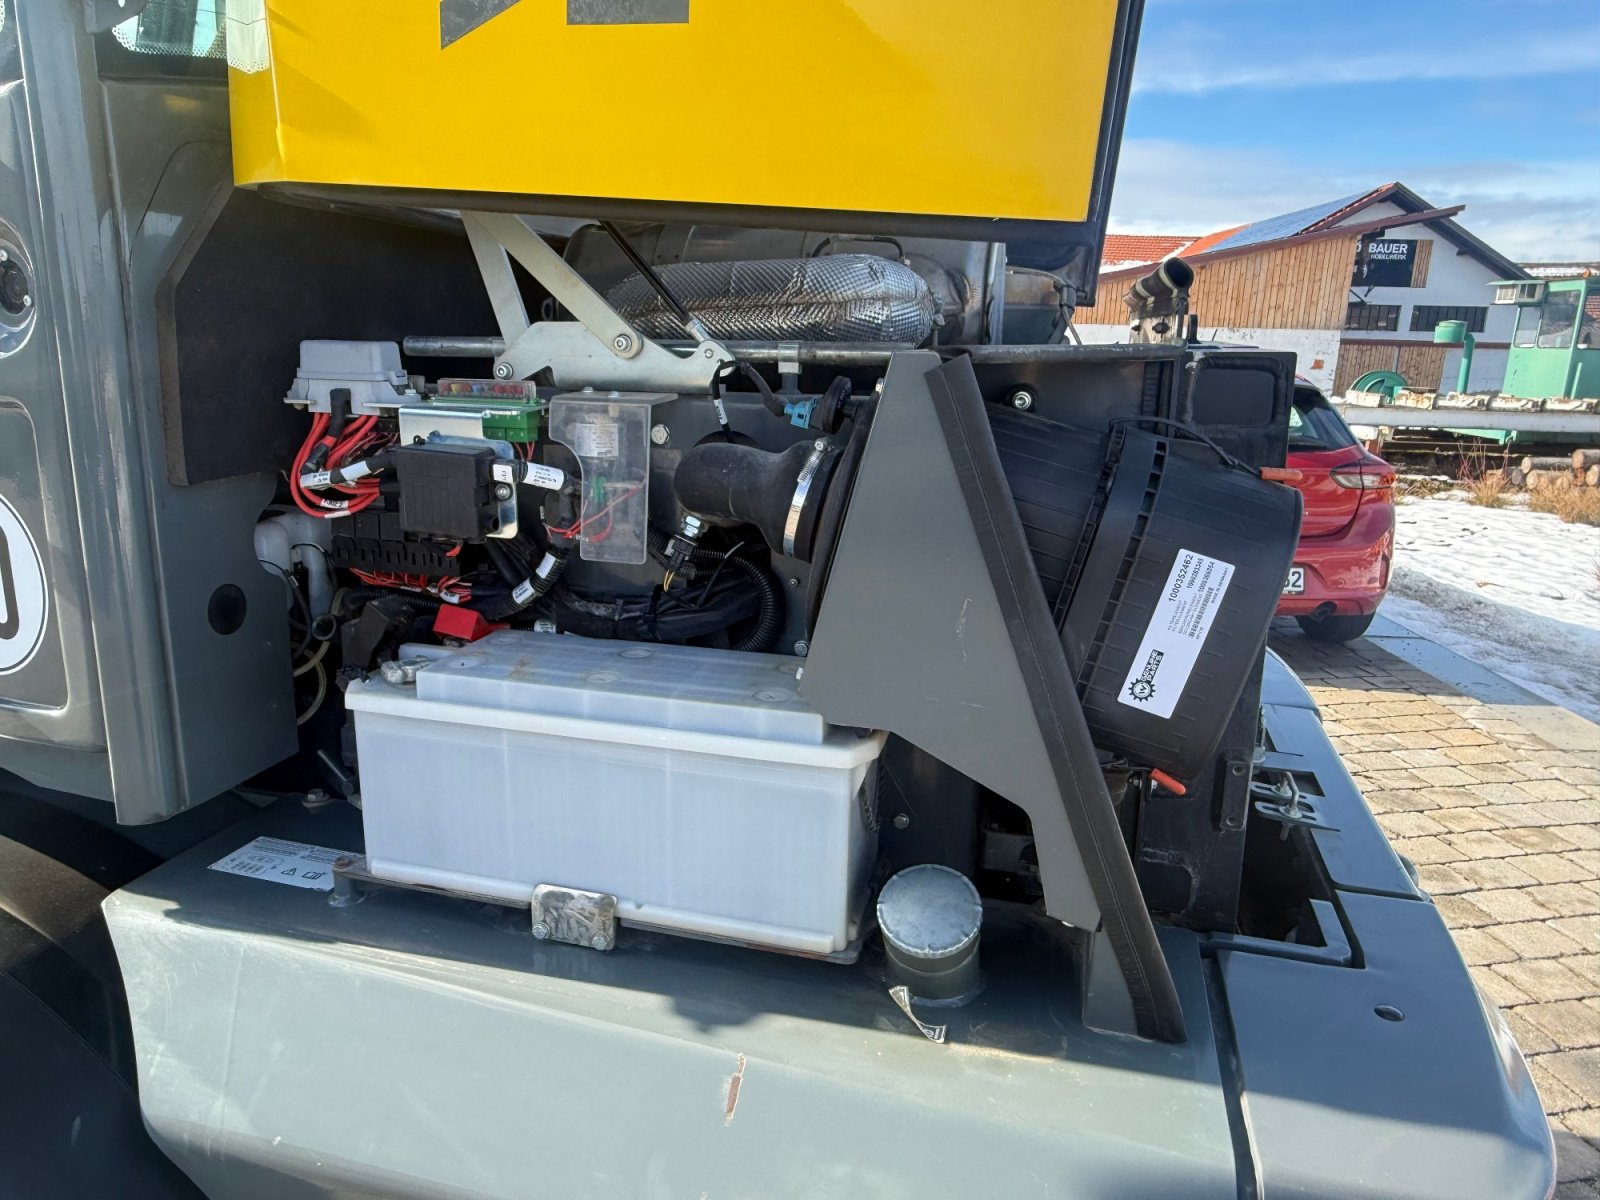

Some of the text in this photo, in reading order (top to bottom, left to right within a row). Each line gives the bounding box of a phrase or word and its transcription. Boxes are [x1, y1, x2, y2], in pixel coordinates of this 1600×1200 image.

[1368, 242, 1408, 254] BAUER
[1168, 554, 1193, 601] 1000352462
[1140, 651, 1157, 681] GENUINE
[1146, 655, 1161, 681] PARTS
